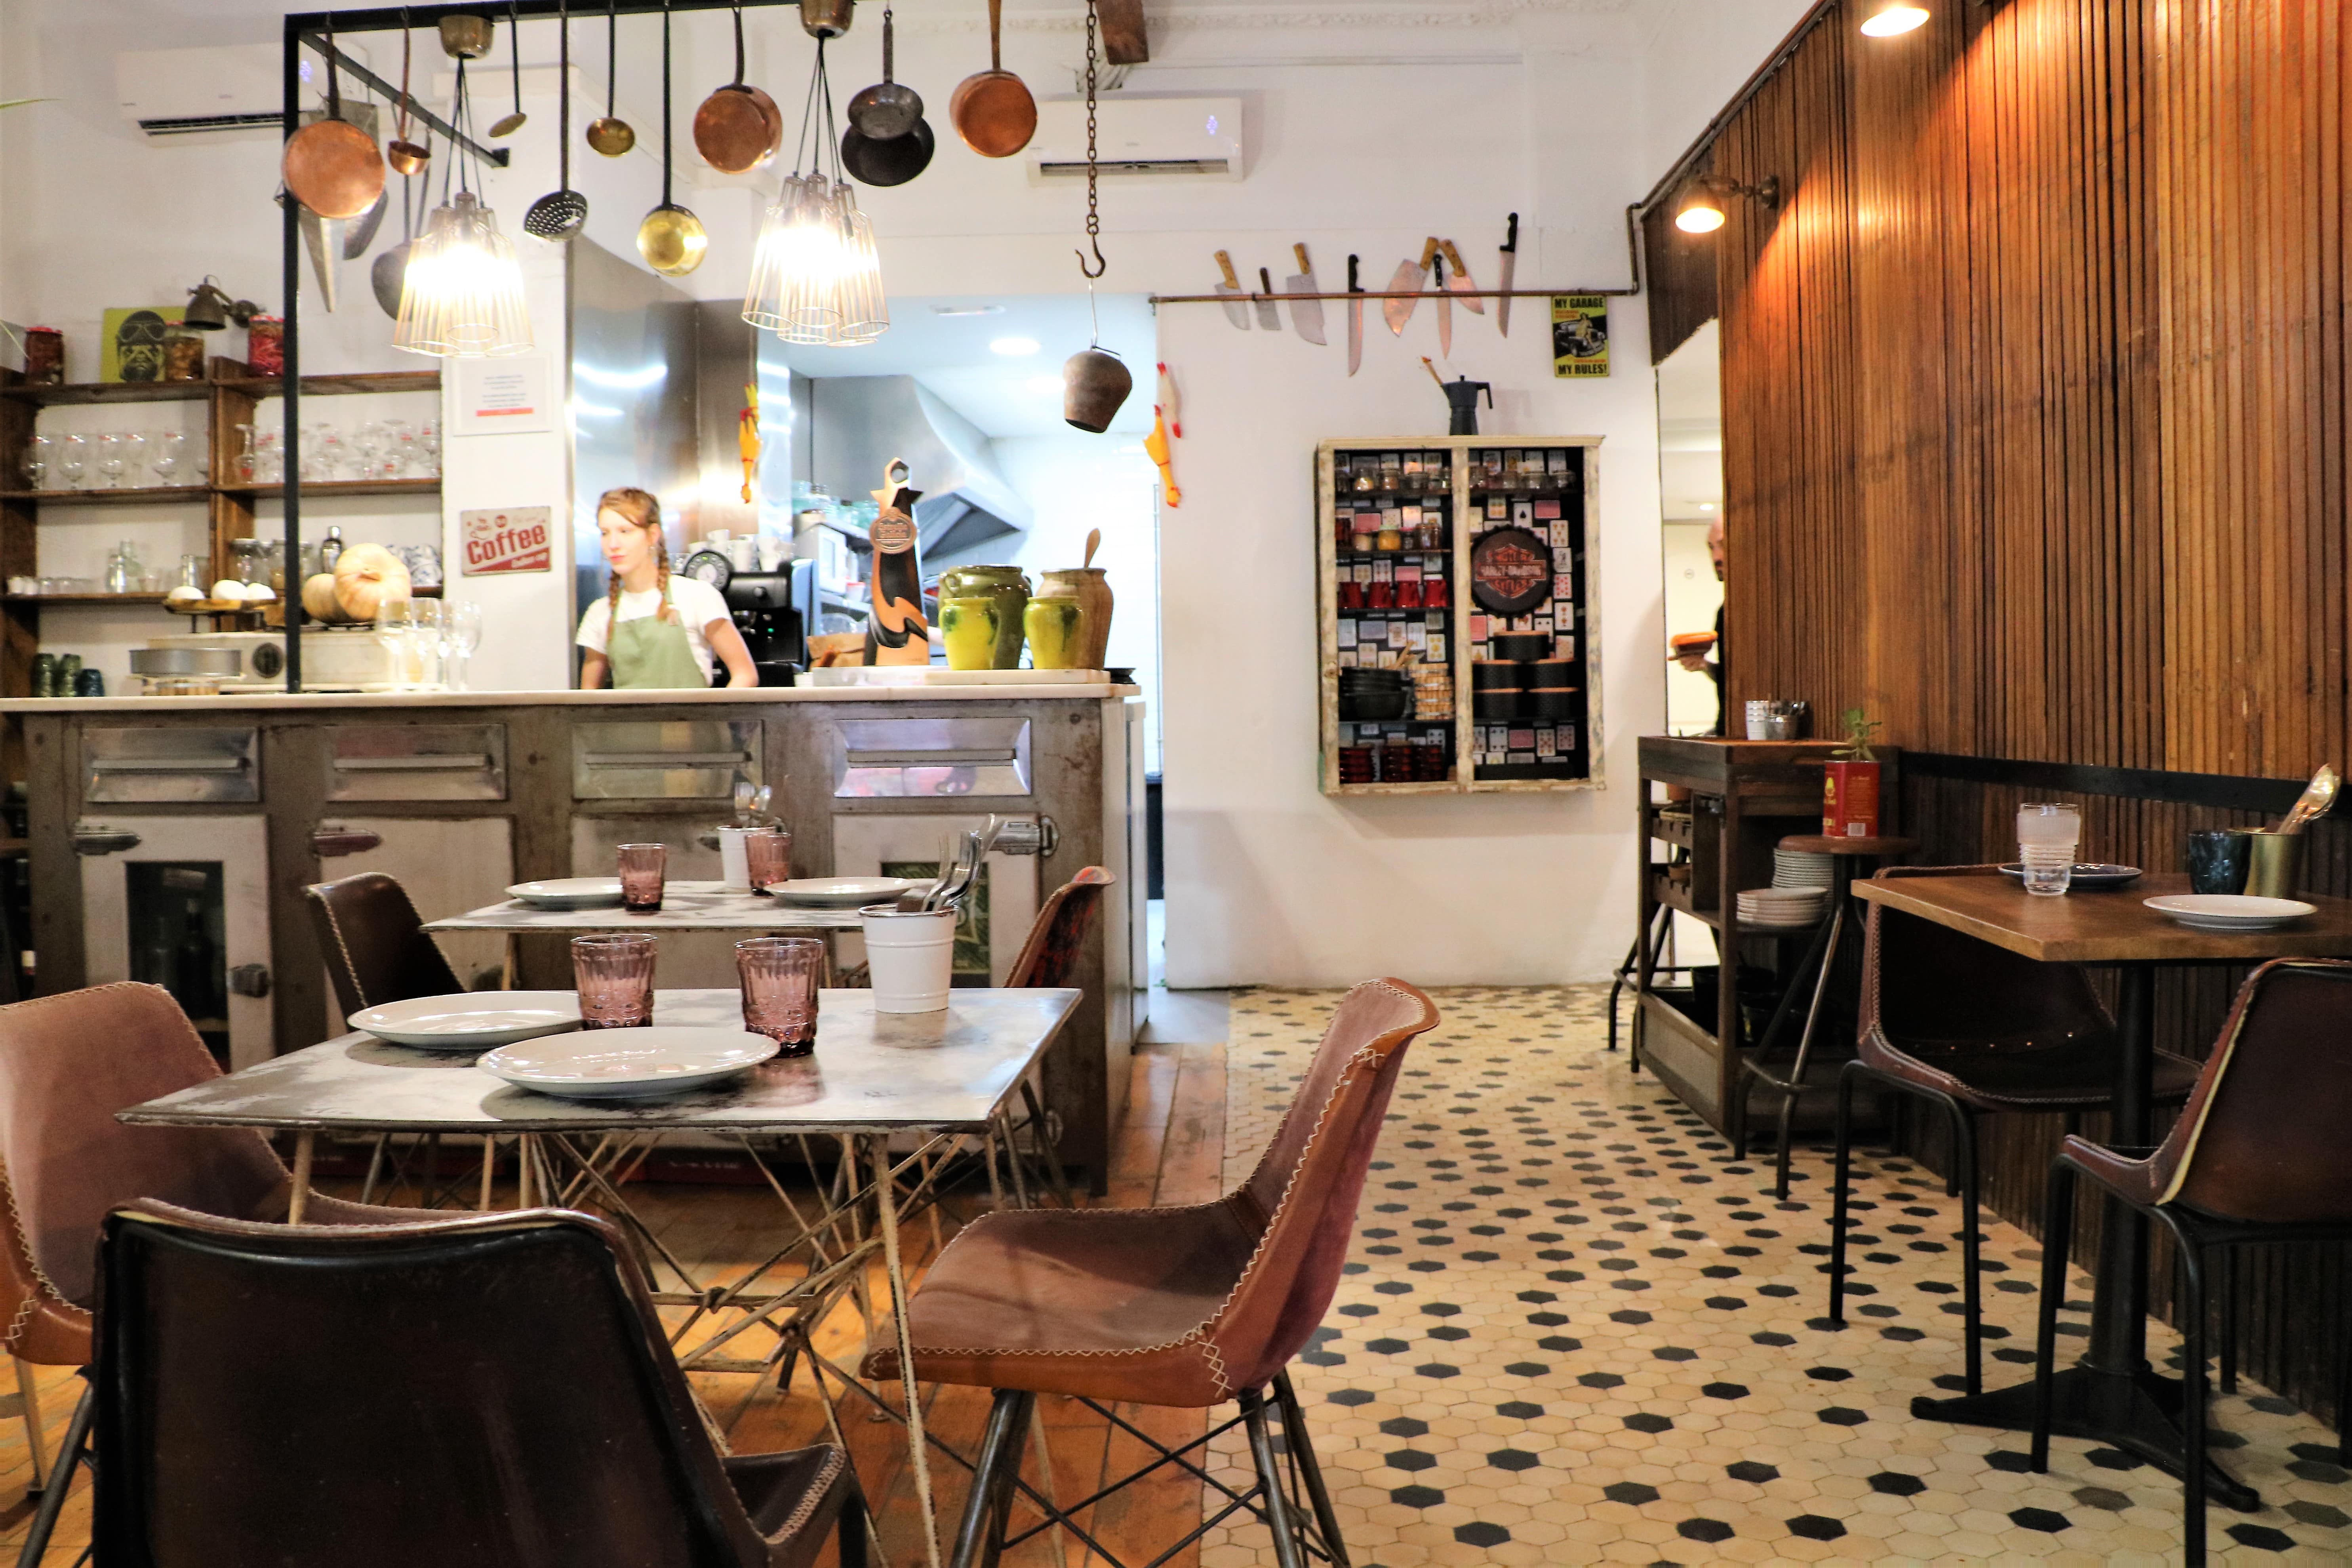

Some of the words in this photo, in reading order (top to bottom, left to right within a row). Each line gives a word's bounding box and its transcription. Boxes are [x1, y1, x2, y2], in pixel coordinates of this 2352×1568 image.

[1555, 298, 1567, 308] MY
[1570, 297, 1604, 308] GARAGE
[1558, 364, 1571, 374] MY
[1575, 364, 1607, 374] RULES!
[467, 524, 547, 565] Coffee
